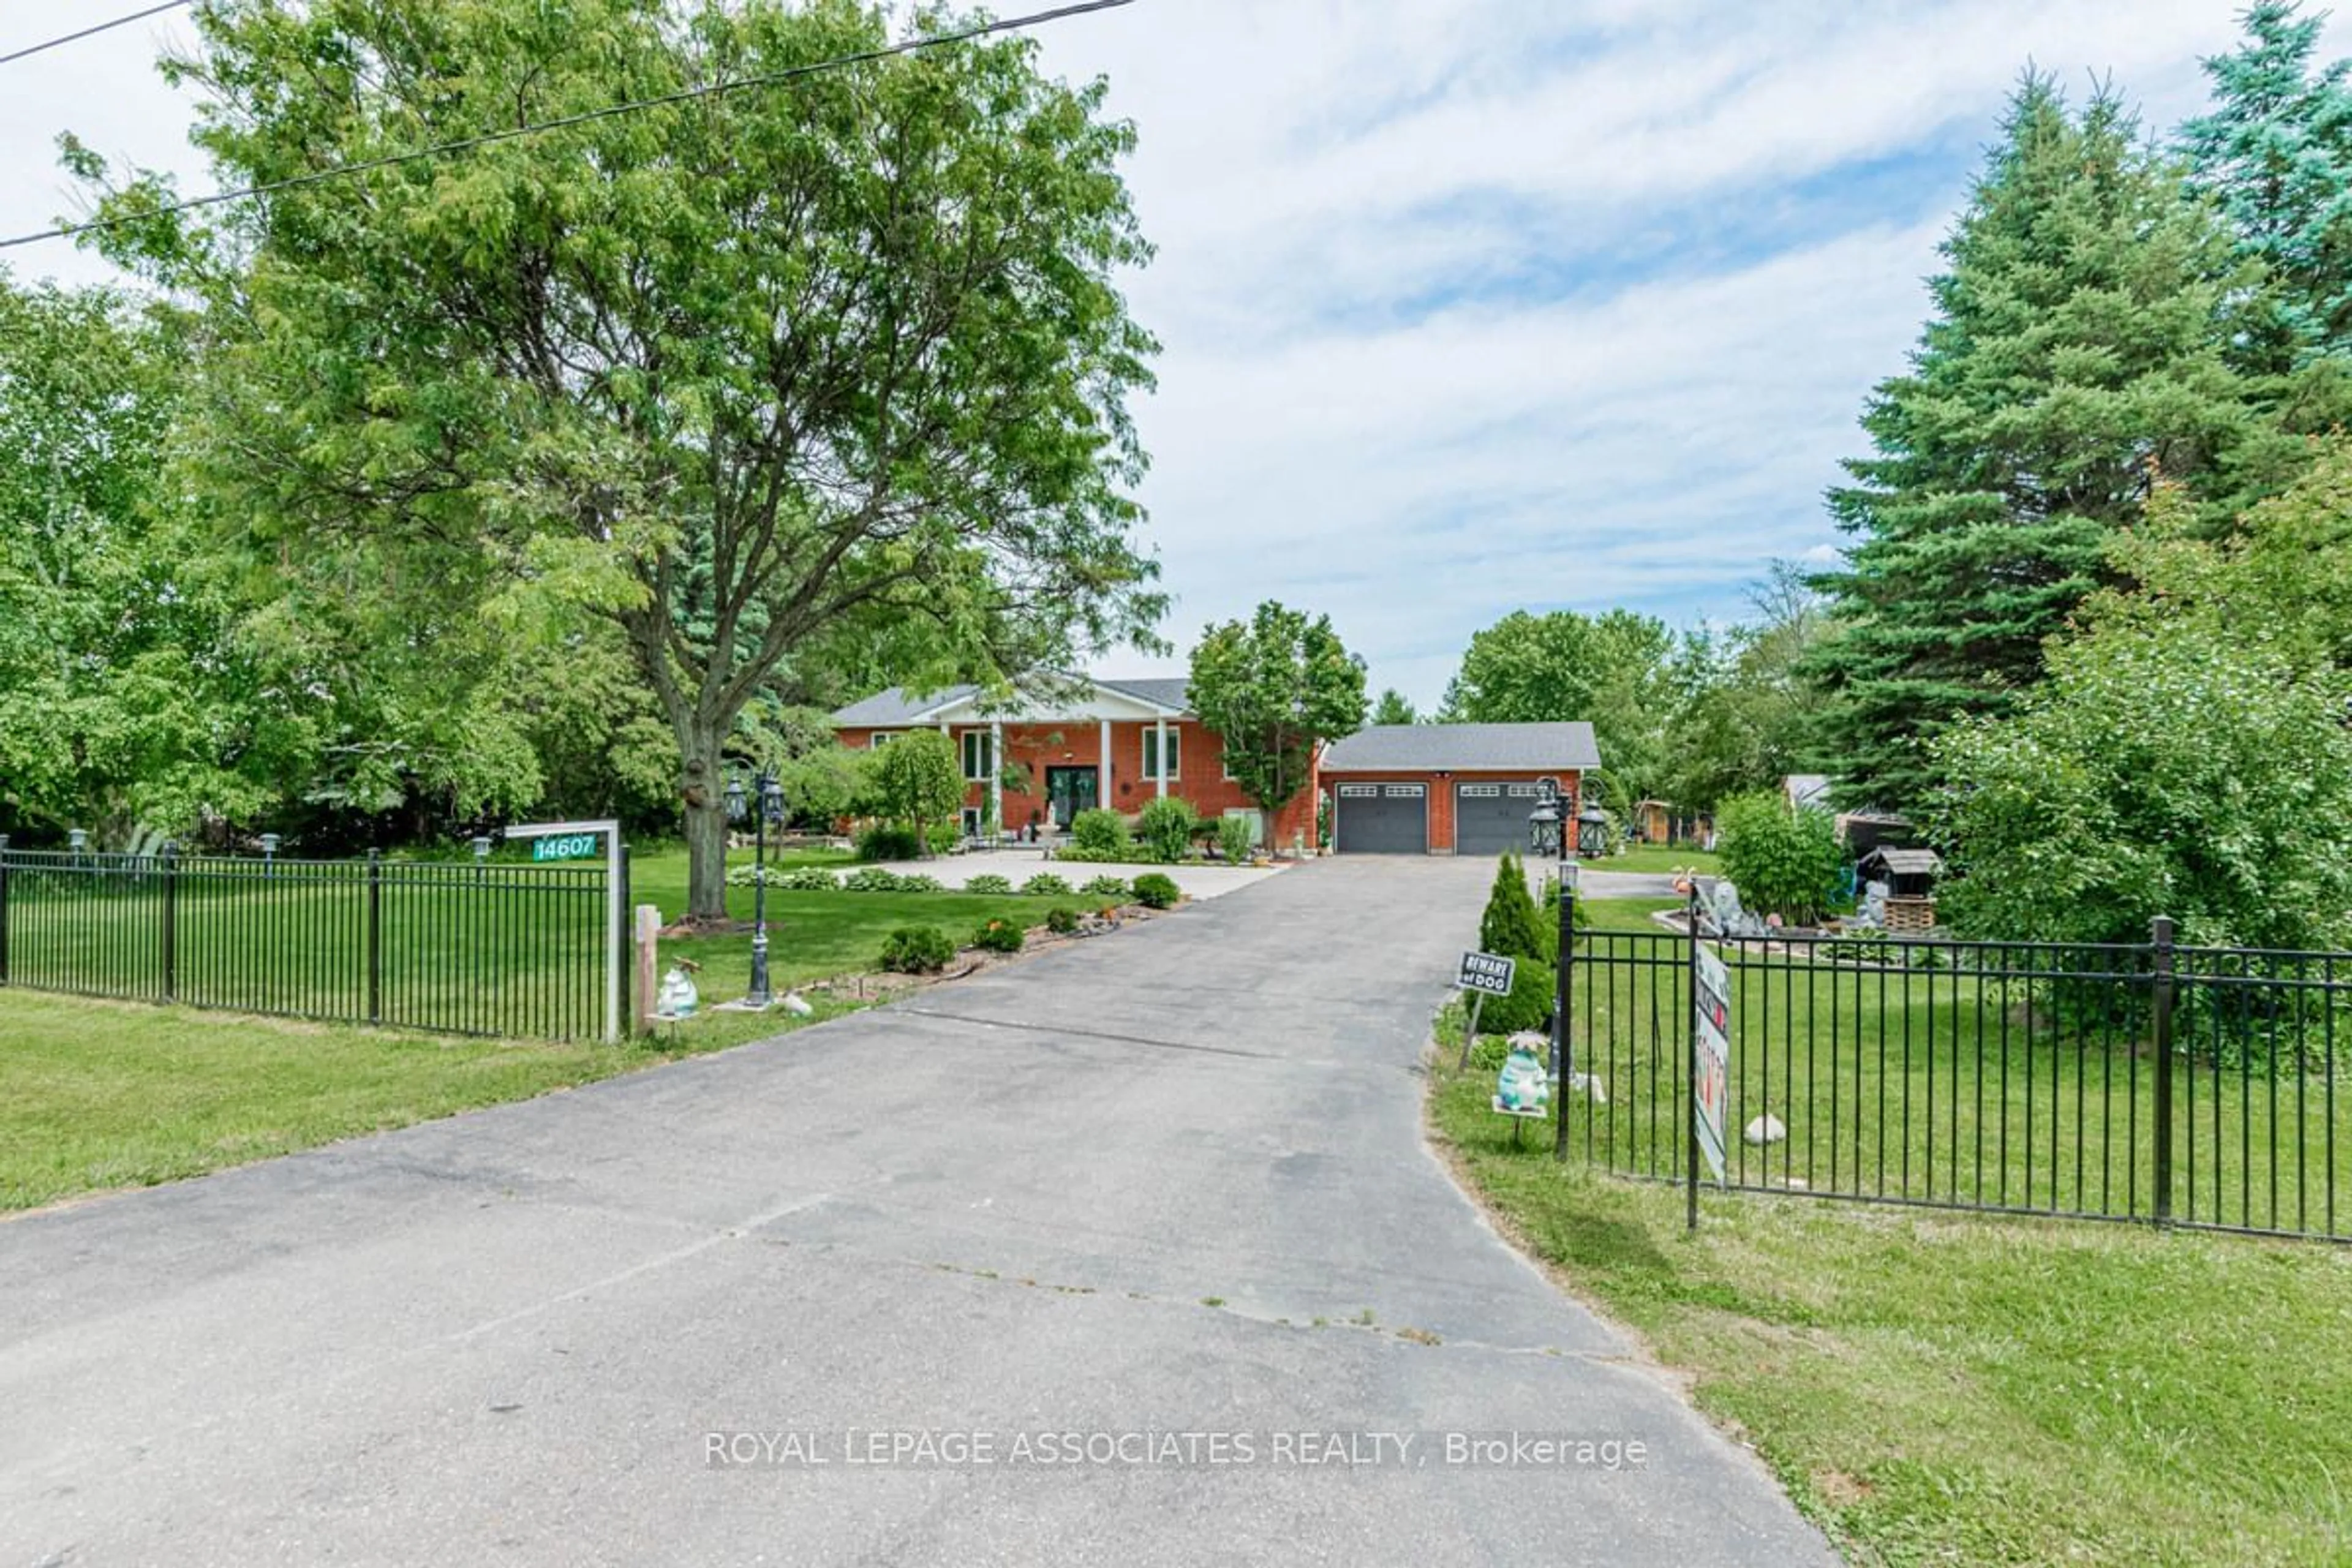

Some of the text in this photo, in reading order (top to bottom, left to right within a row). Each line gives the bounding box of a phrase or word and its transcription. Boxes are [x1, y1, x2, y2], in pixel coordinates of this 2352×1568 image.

[537, 836, 594, 859] 14607
[1466, 956, 1507, 978] BEWARE
[1475, 973, 1505, 990] DOG
